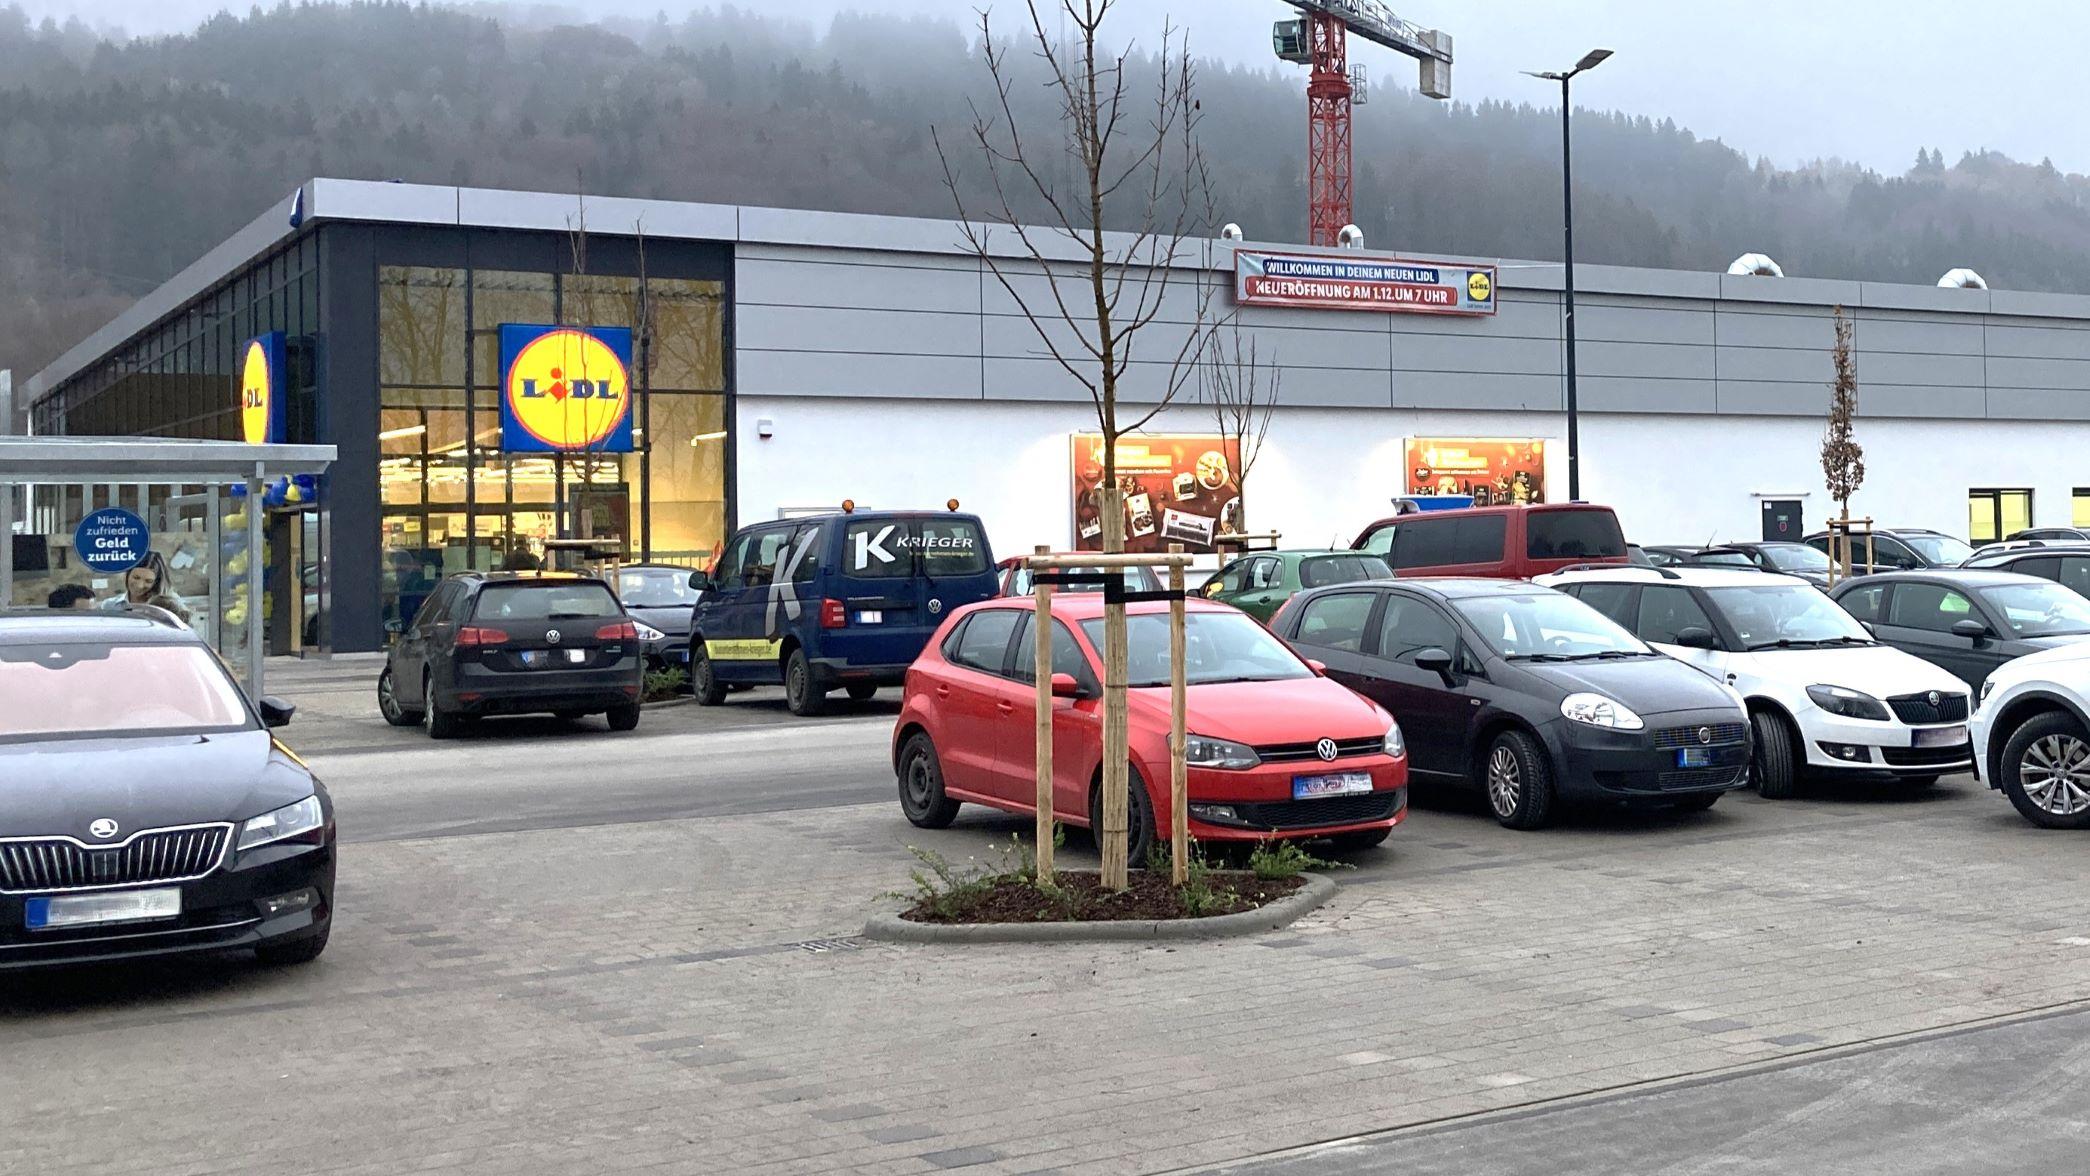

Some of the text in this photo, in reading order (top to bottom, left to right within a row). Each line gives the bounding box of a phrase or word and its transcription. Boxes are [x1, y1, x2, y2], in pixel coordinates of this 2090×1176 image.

[1266, 262, 1435, 283] WILLKOMMEN IN DEINEM NEUEN LIDL
[1255, 280, 1351, 298] NEUERÖFFNUNG
[1353, 286, 1371, 299] AM
[1415, 288, 1421, 302] 7
[1423, 290, 1448, 304] UHR
[1470, 281, 1489, 291] LIDL
[520, 367, 619, 404] LIDL
[97, 515, 127, 525] Nicht
[86, 526, 138, 536] zufrieden
[94, 537, 130, 549] Geld
[854, 524, 896, 570] K
[896, 536, 973, 548] KRIEGER
[87, 550, 137, 562] zurück
